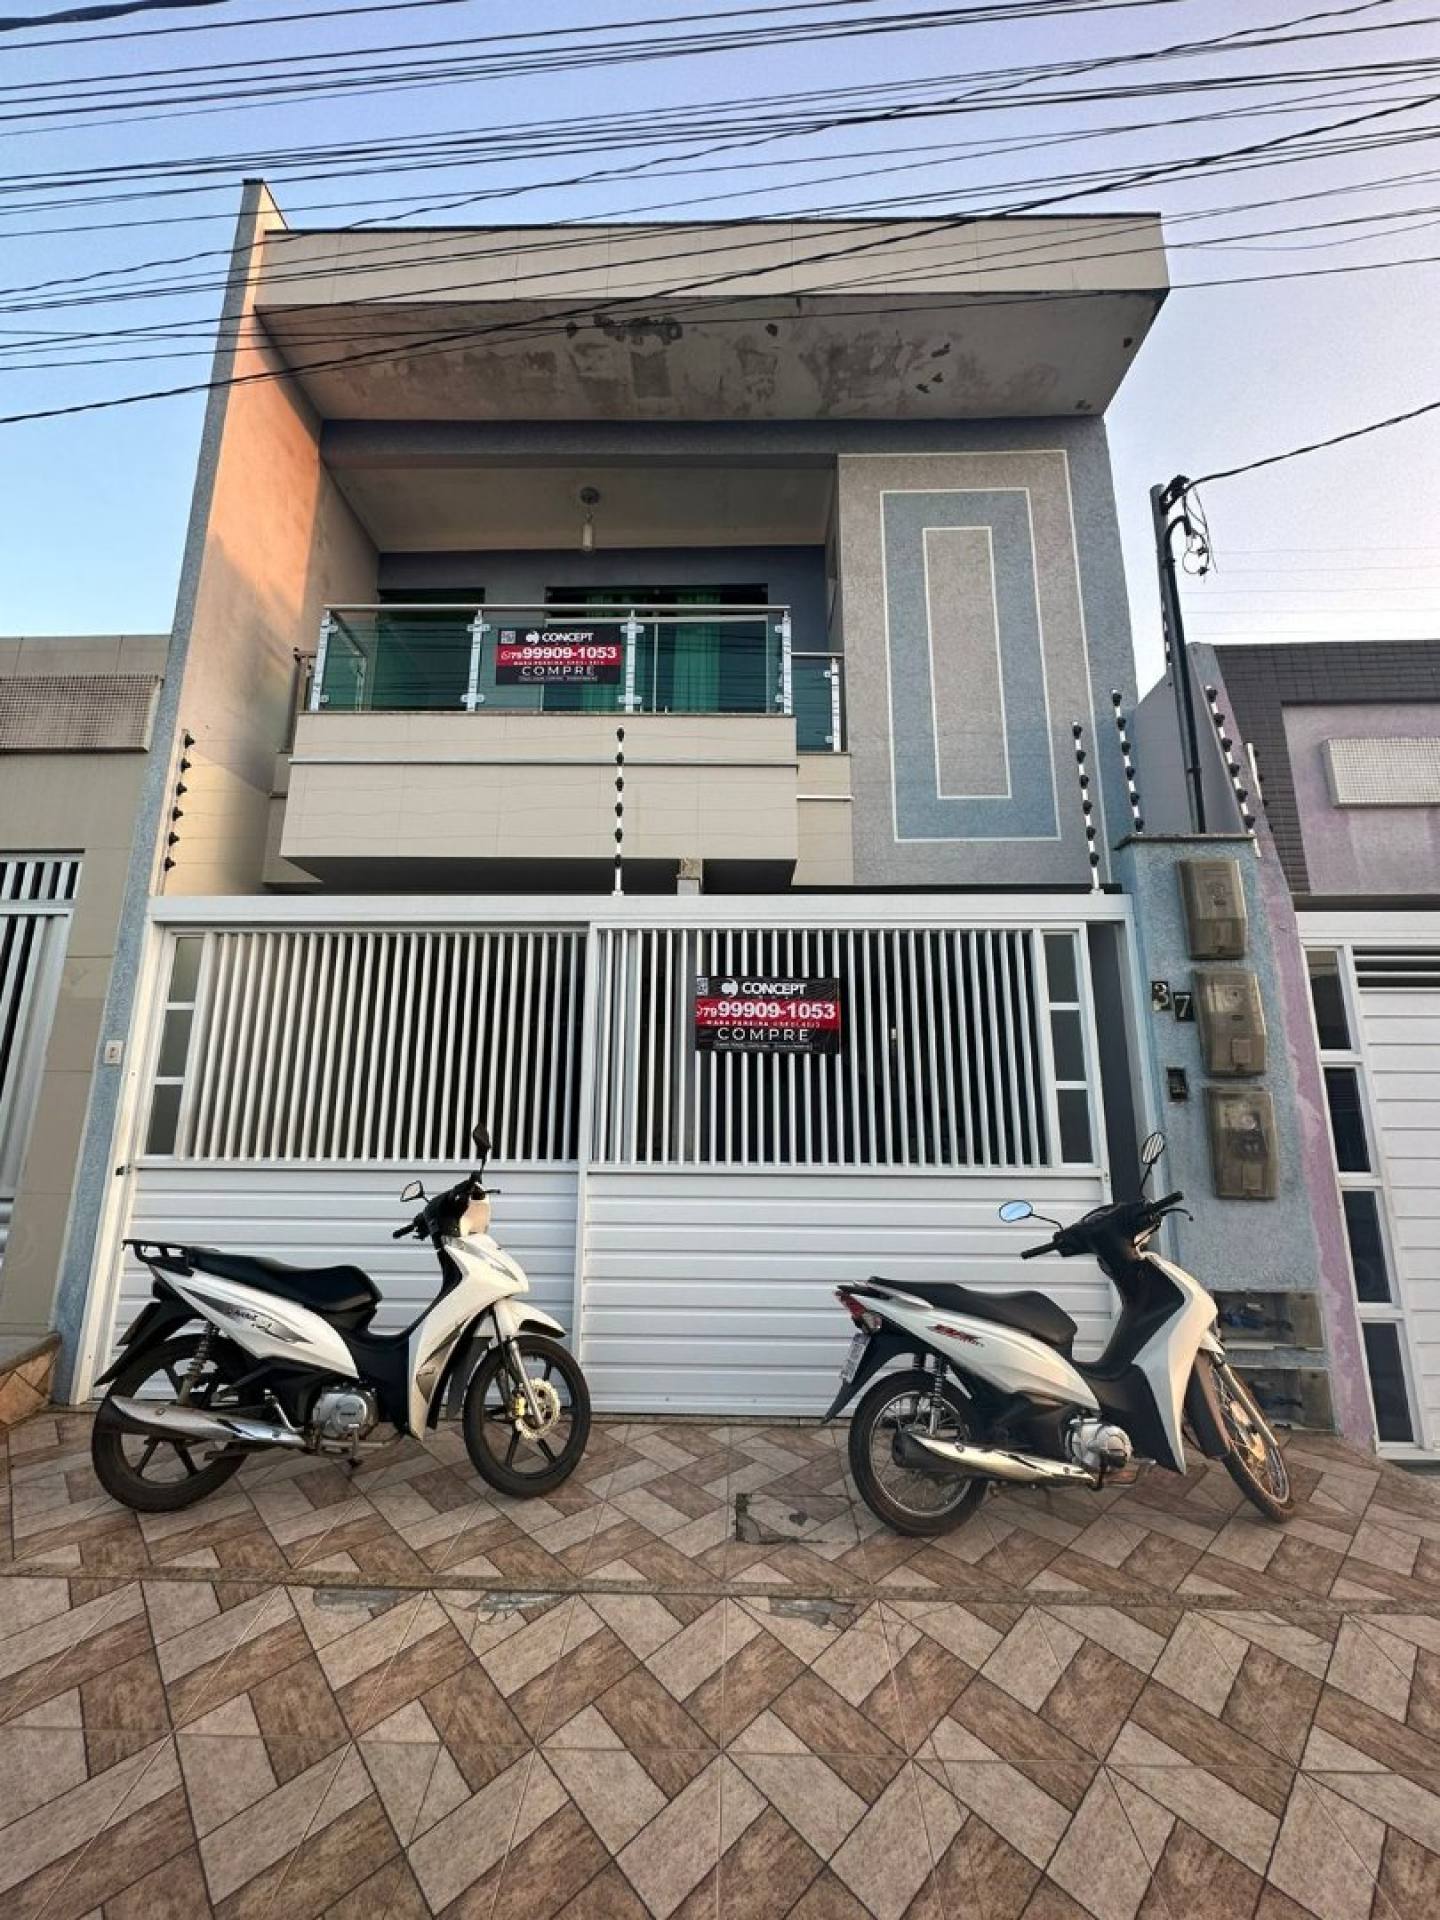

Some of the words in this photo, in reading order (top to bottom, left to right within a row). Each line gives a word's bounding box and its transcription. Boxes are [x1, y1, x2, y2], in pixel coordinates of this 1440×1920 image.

[541, 632, 594, 642] CONCEPT
[522, 646, 617, 659] 99909-1053
[522, 666, 594, 676] COMPRE
[742, 982, 807, 995] CONCEPT
[717, 1001, 836, 1019] 99909-1053
[717, 1027, 809, 1041] COMPRE
